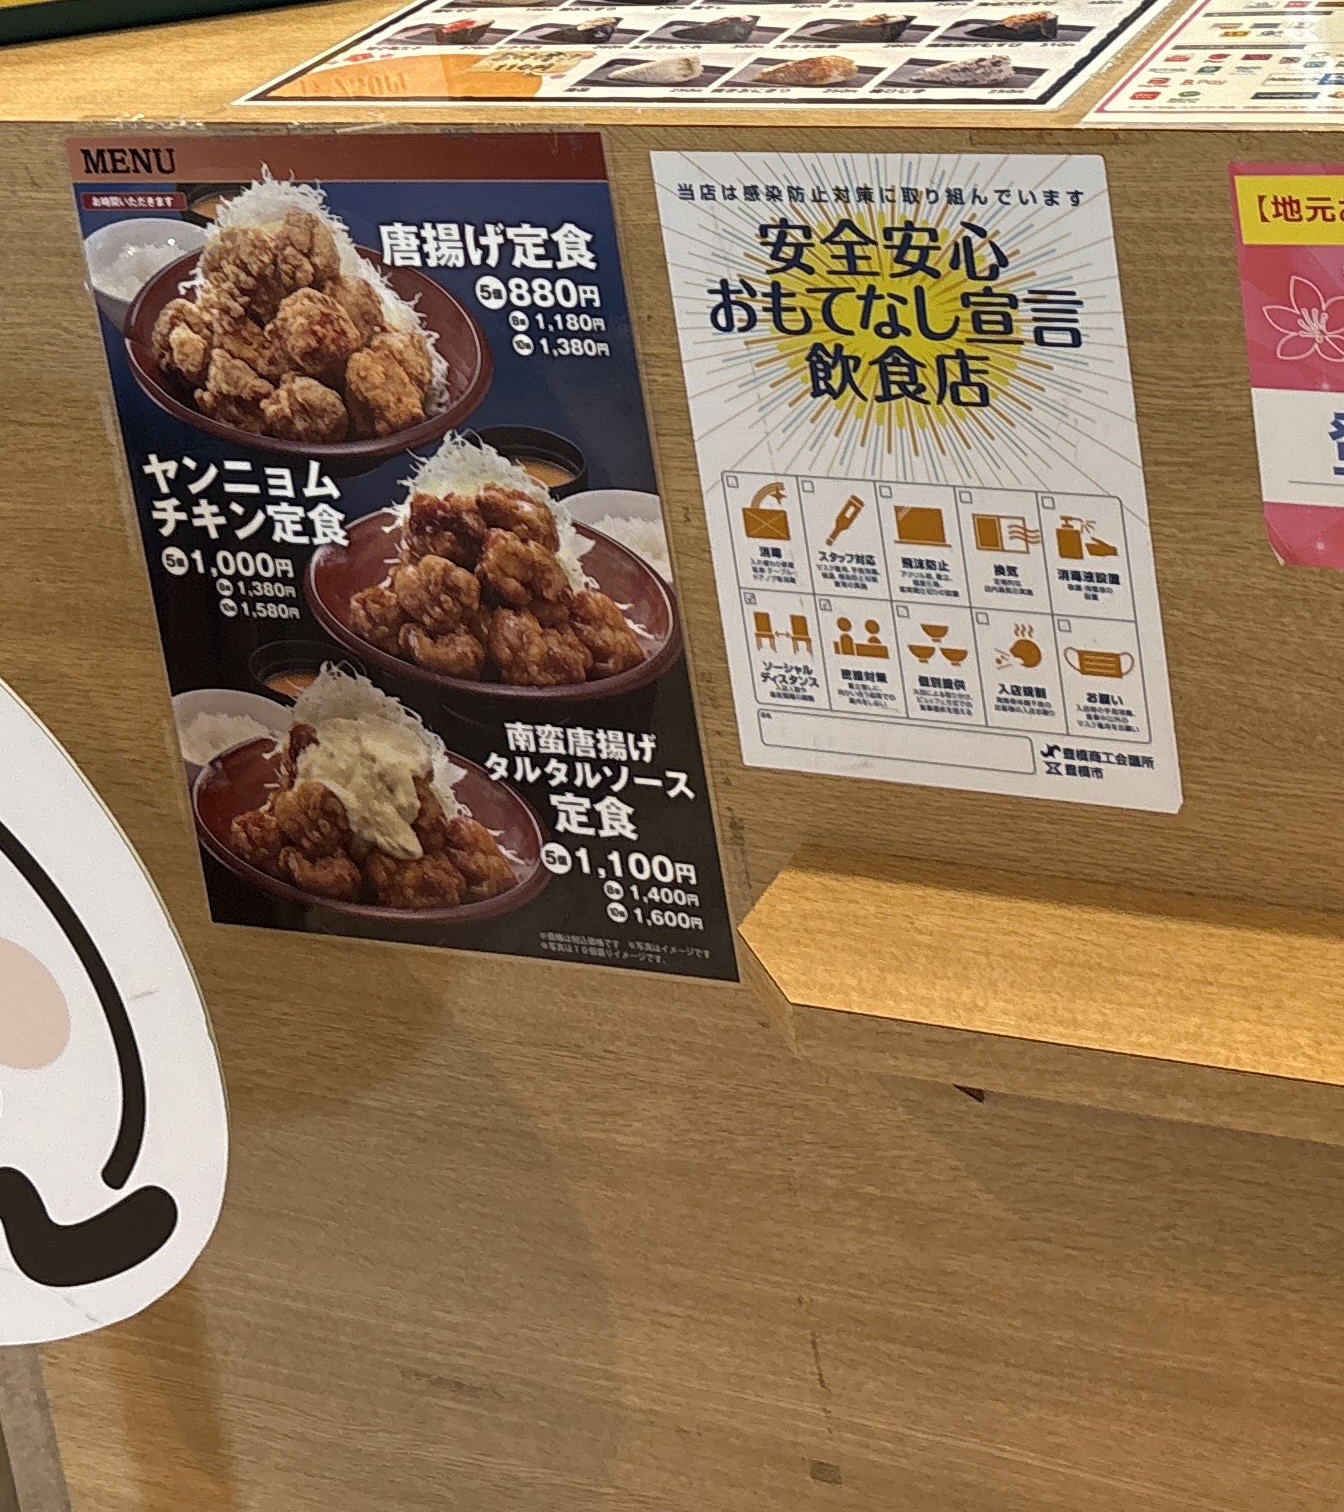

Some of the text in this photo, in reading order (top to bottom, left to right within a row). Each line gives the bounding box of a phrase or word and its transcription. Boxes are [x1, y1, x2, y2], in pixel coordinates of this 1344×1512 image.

[83, 146, 177, 176] MENU
[677, 182, 1085, 208] 当店は感染防止対策に取り組んでいます
[378, 222, 598, 270] 唐揚げ定食
[758, 218, 1010, 281] 安全安心
[508, 277, 602, 308] 880円
[535, 313, 606, 333] 1,180円
[706, 277, 1084, 349] おもてなし宣言
[539, 337, 611, 357] 1,380円
[806, 341, 990, 408] 飲食店
[142, 453, 342, 500] ヤンニョム
[151, 496, 350, 547] チキン定食
[191, 548, 295, 578] 1,000円
[817, 550, 877, 566] スタッフ対応
[236, 580, 297, 599] 1,380円
[240, 601, 301, 620] 1,580円
[759, 672, 820, 689] ディスタンス
[762, 660, 814, 675] ソーシャル
[503, 721, 657, 764] 南蛮唐揚げ
[483, 752, 697, 802] タルタルソース
[548, 791, 640, 841] 定食
[575, 846, 698, 886] 1,100円
[630, 884, 700, 908] 1,400円
[633, 907, 704, 931] 1,600円
